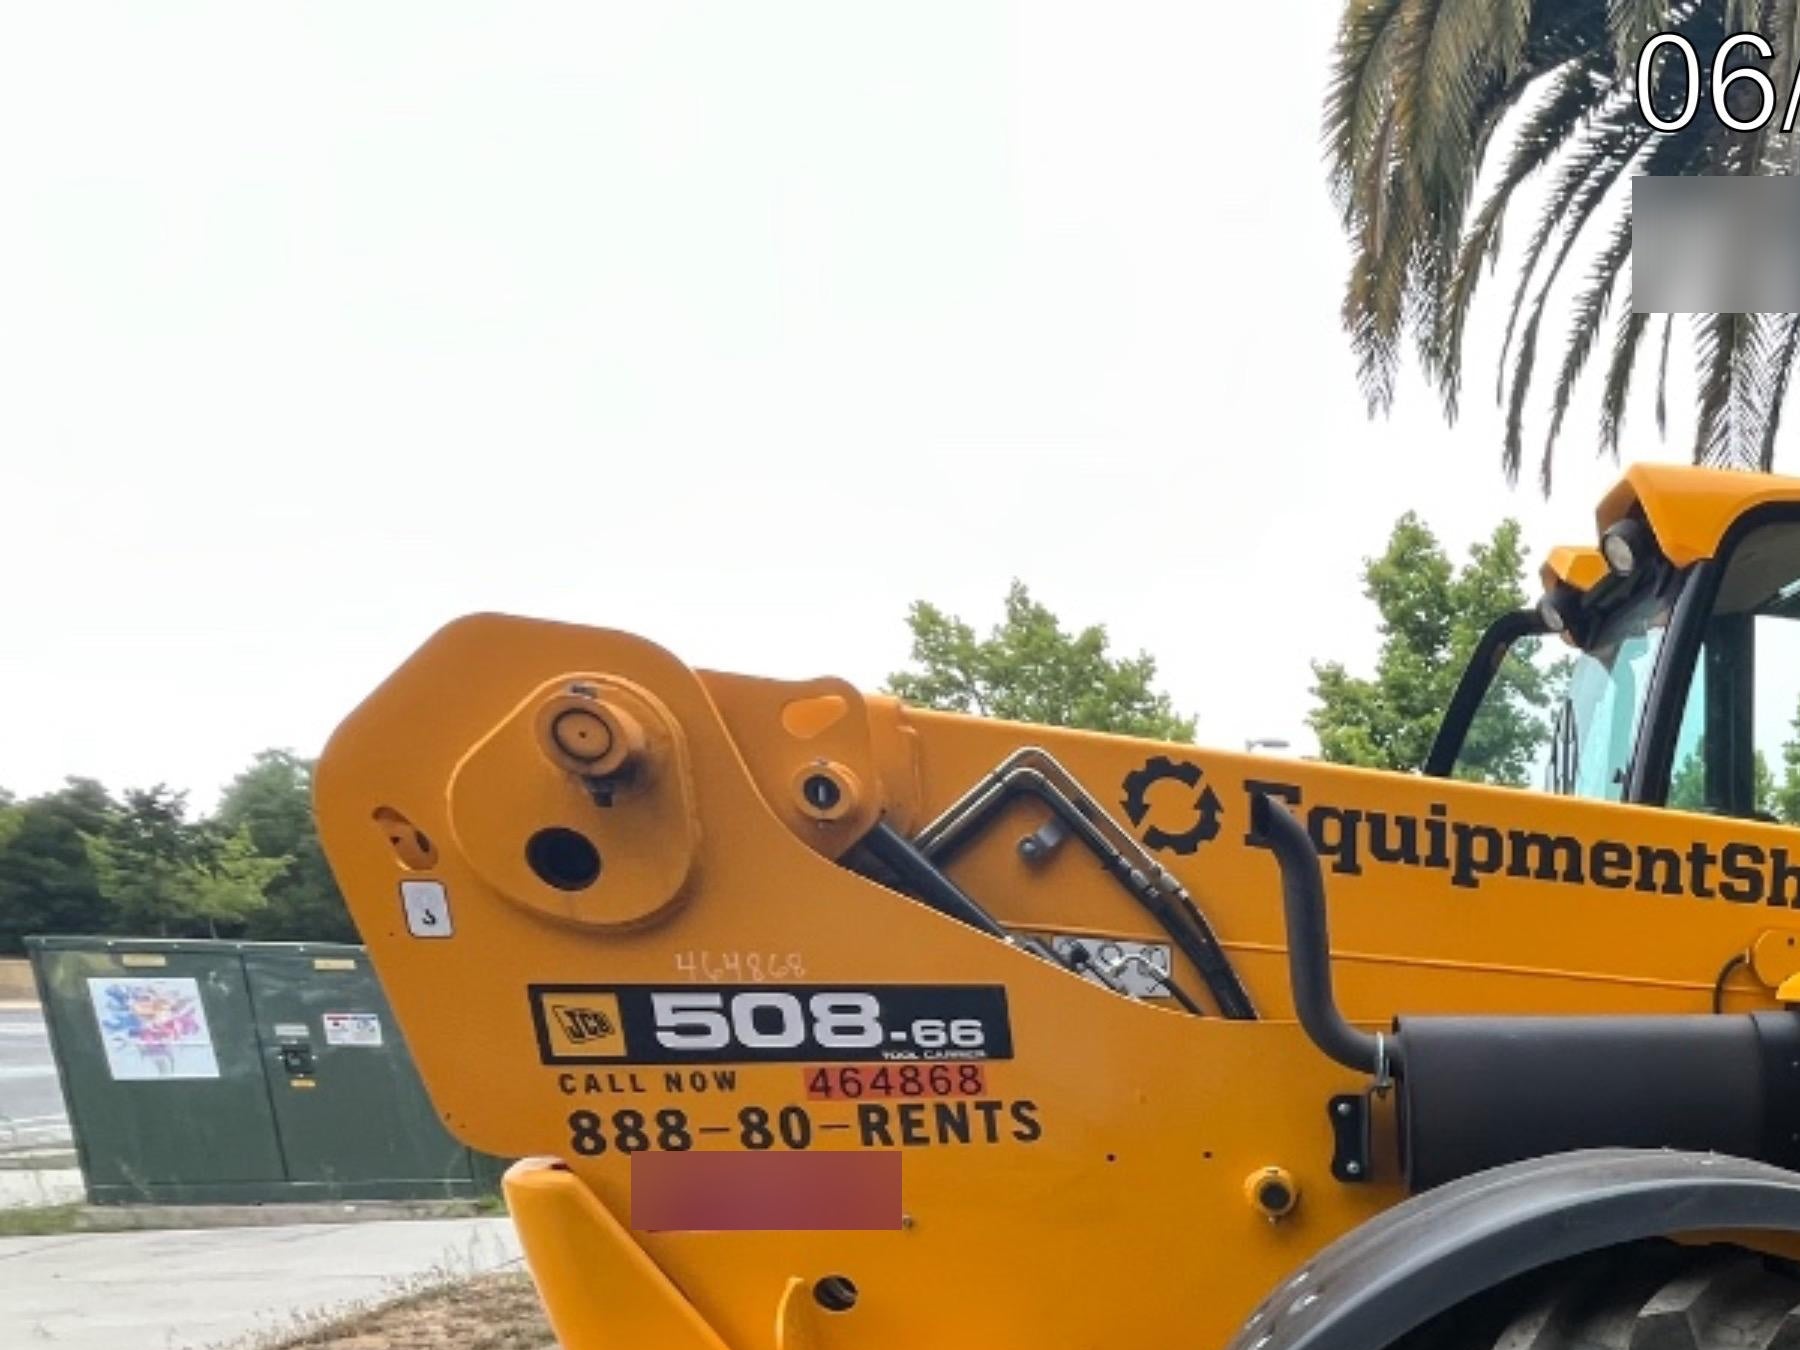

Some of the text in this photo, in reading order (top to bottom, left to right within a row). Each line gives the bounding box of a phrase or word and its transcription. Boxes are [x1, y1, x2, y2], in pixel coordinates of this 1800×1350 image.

[558, 1070, 736, 1094] CALL NOW
[809, 1064, 983, 1099] 464868
[568, 1100, 1042, 1156] 888-80-RENTS
